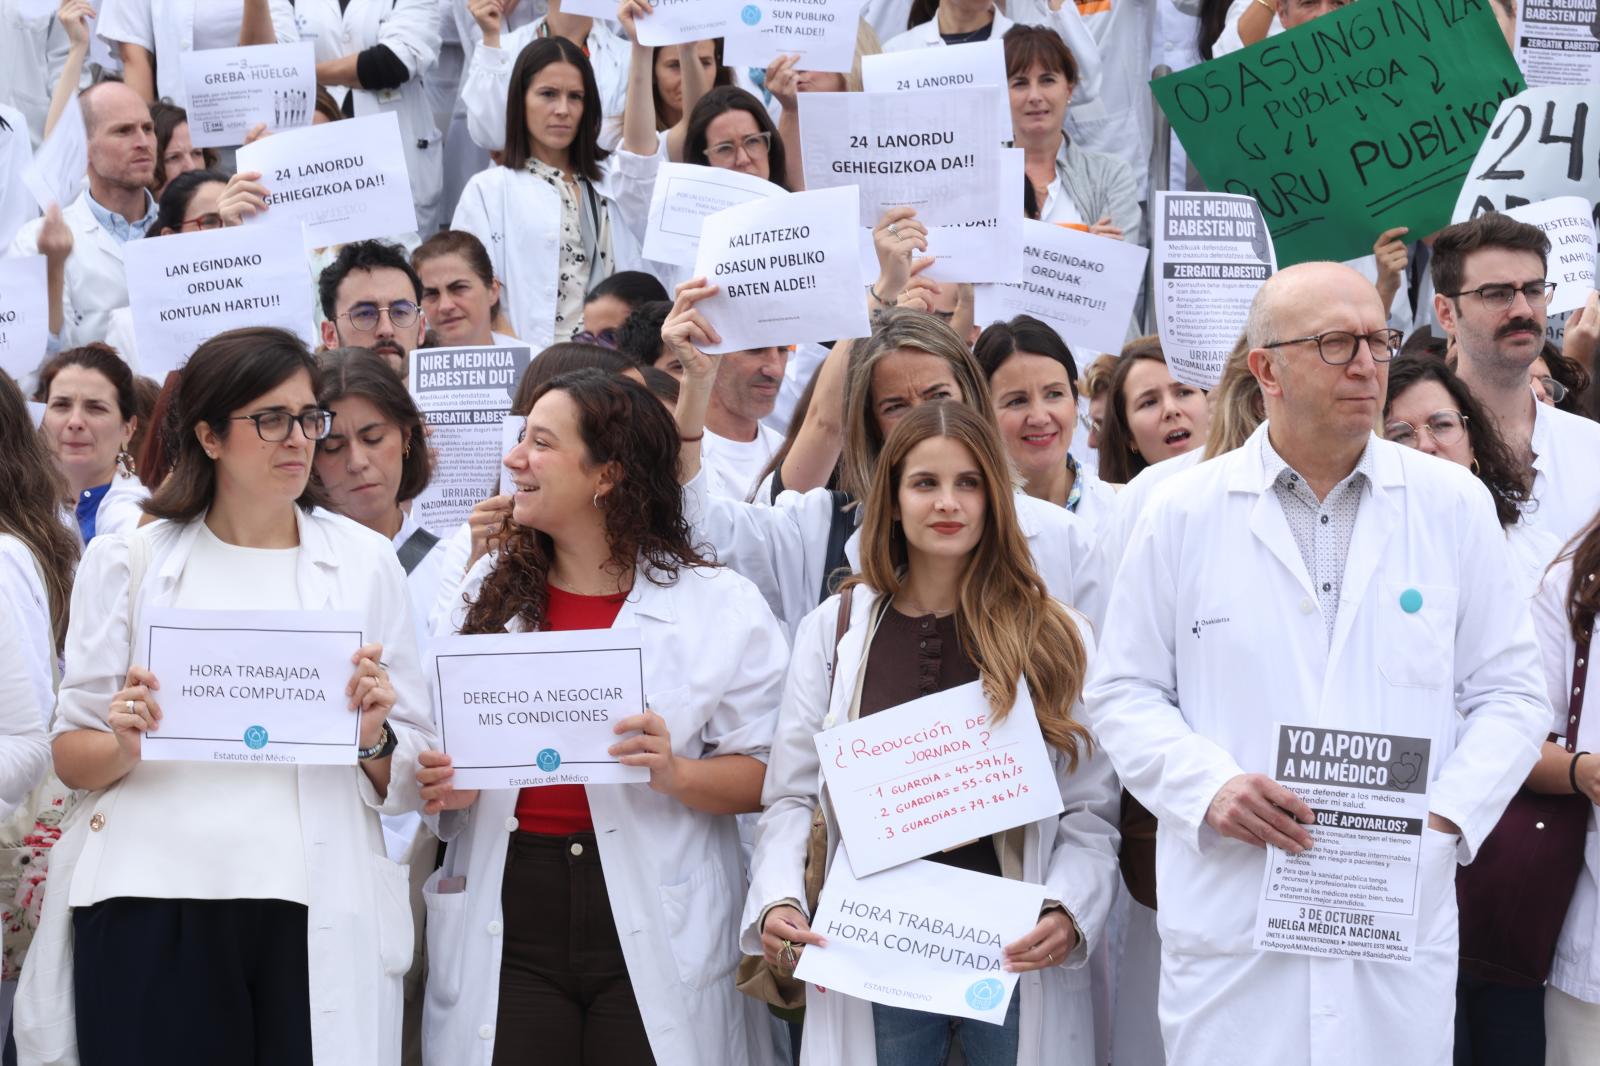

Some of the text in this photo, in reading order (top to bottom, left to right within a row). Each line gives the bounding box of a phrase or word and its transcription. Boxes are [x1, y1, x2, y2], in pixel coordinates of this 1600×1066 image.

[795, 11, 835, 22] PUBLIKO
[1526, 8, 1598, 23] BABESTEN DUT
[794, 26, 825, 36] ALDE!!
[1528, 38, 1600, 52] ZERGATIK BABESTU?
[204, 67, 299, 84] GREBA HUELGA
[896, 73, 974, 90] 24 LANORDU
[850, 131, 954, 149] 24 LANORDU
[1475, 100, 1589, 182] 24
[274, 155, 365, 182] 24 LANORDU
[832, 154, 975, 174] GEHIEGIZKOA DA!!
[262, 174, 386, 206] GEHIEGIZKOA DA!!
[1169, 200, 1254, 219] NIRE MEDIKUA
[728, 225, 810, 248] KALITATEZKO
[1168, 220, 1256, 238] BABESTEN DUT
[166, 254, 262, 278] LAN EGINDAKO
[714, 250, 825, 276] OSASUN PUBLIKO
[1043, 250, 1105, 273] EGINDAKO
[1560, 252, 1586, 264] NAHI
[1031, 265, 1082, 286] ORDUAK
[1174, 265, 1266, 279] ZERGATIK BABESTU?
[1564, 272, 1577, 283] EZ
[187, 276, 244, 295] ORDUAK
[728, 275, 816, 298] BATEN ALDE!!
[160, 294, 281, 322] KONTUAN HARTU!!
[1057, 290, 1108, 312] HARTU!!
[420, 352, 515, 371] NIRE MEDIKUA
[420, 369, 516, 388] BABESTEN DUT
[425, 411, 472, 424] ZERGATIK
[442, 488, 487, 498] URRIAREN
[421, 499, 473, 510] NAZIOMAILAKO
[189, 664, 320, 682] HORA TRABAJADA
[182, 684, 326, 702] HORA COMPUTADA
[463, 687, 624, 704] DERECHO A NEGOCIAR
[478, 709, 609, 726] MIS CONDICIONES
[965, 714, 988, 730] DE
[905, 740, 971, 765] JORNADA
[1288, 729, 1392, 762] YO APOYO
[213, 751, 296, 762] Estatuto del Médico
[509, 774, 589, 786] Estatuto del Médico
[1284, 758, 1389, 786] A MI MÉDICO
[1312, 788, 1349, 799] defender
[1357, 792, 1369, 800] los
[1371, 794, 1406, 803] médicos
[1330, 798, 1366, 810] mi salud.
[880, 808, 890, 818] 2
[1316, 811, 1338, 826] QUÉ
[1340, 814, 1408, 833] APOYARLOS?
[884, 827, 895, 839] 3
[1326, 831, 1356, 840] consultas
[1358, 834, 1380, 842] tengan
[1388, 836, 1412, 846] tiempo
[1322, 848, 1339, 856] haya
[1340, 850, 1367, 858] guardias
[1368, 852, 1412, 862] interminables
[1328, 856, 1348, 864] riesgo
[1354, 858, 1385, 867] pacientes
[1282, 875, 1309, 884] recursos
[1315, 878, 1357, 890] profesionales
[1283, 867, 1296, 875] Para
[1297, 869, 1310, 877] que
[1318, 871, 1343, 880] sanidad
[1344, 872, 1368, 882] pública
[1369, 876, 1387, 884] tenga
[1279, 893, 1366, 907] estaremos mejor atendidos.
[1281, 885, 1303, 893] Porque
[1321, 889, 1348, 898] médicos
[1349, 892, 1367, 900] están
[1385, 895, 1404, 904] todos
[840, 898, 1002, 948] HORA TRABAJADA
[1299, 907, 1375, 926] 3 DE OCTUBRE
[1268, 918, 1402, 942] HUELGA MÉDICA NACIONAL
[827, 920, 1001, 972] HORA COMPUTADA
[1296, 935, 1340, 946] MANIFESTACIONES
[1373, 942, 1385, 950] ESTE
[1386, 944, 1409, 952] MENSAJE
[1328, 948, 1361, 957] #3Octubre
[864, 982, 903, 996] ESTATUTO
